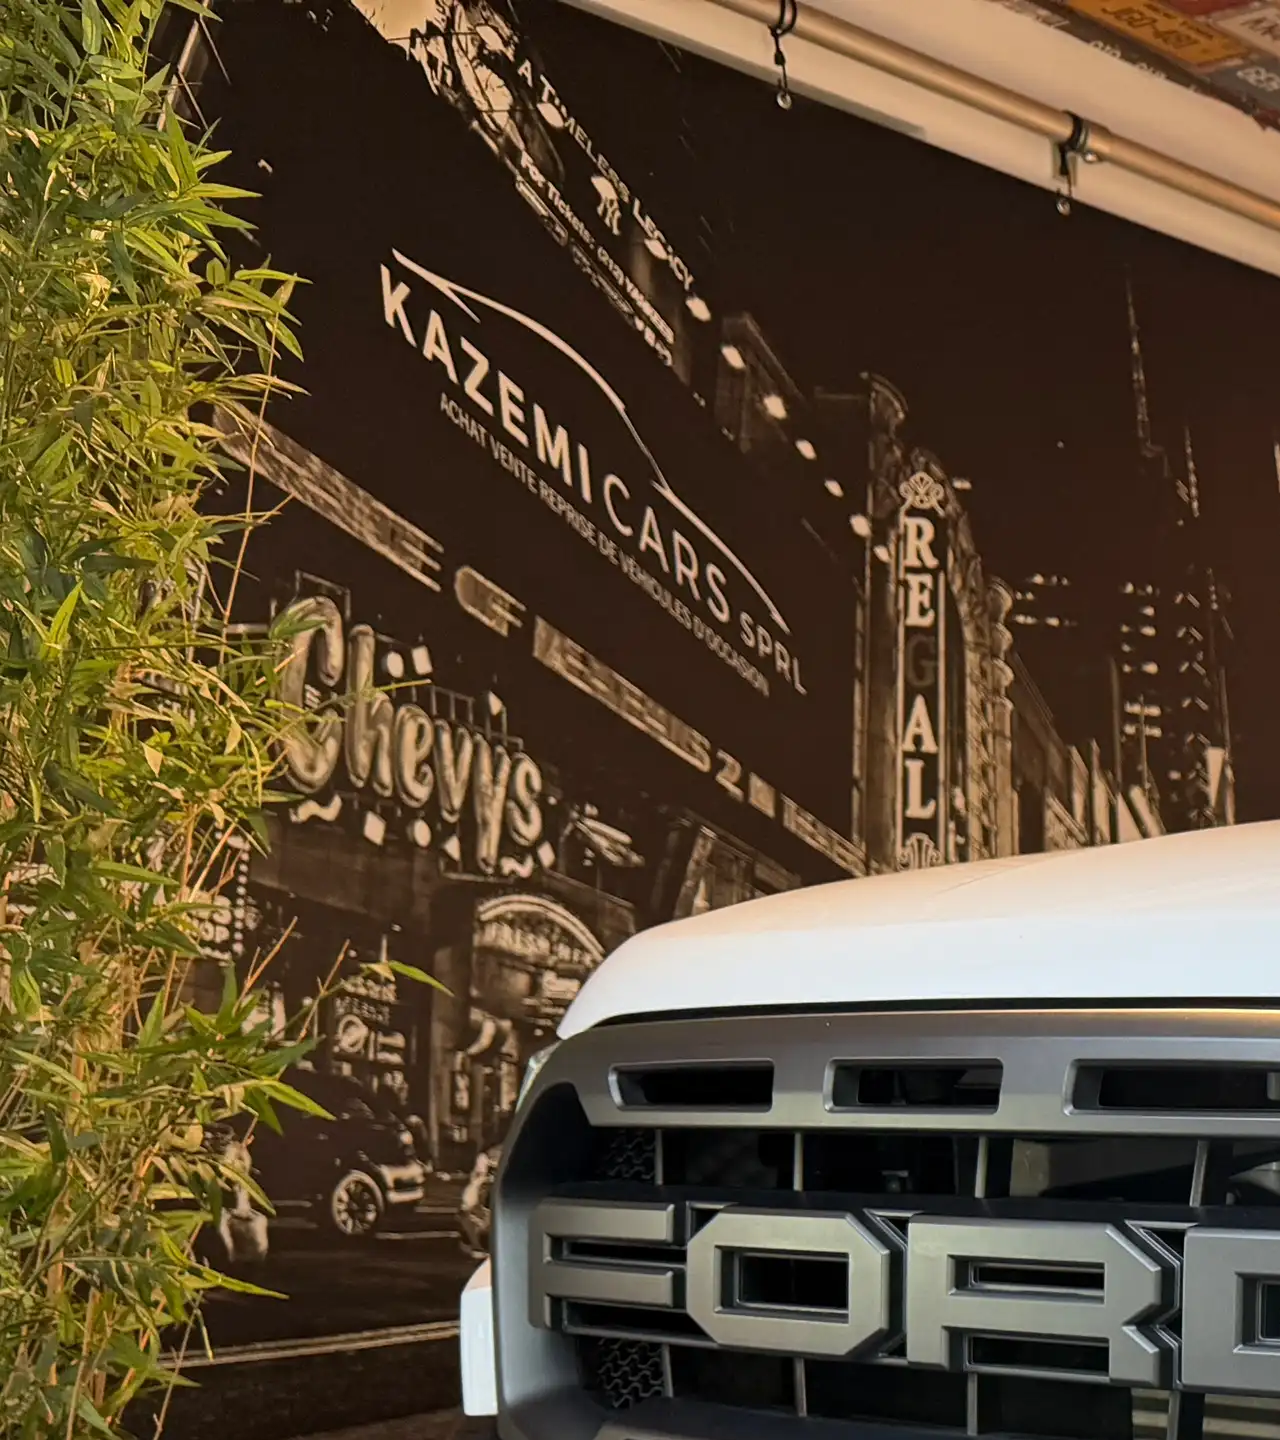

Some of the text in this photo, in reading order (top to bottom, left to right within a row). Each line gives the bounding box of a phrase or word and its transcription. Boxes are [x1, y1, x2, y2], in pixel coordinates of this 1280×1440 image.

[440, 391, 488, 450] ACHAT
[489, 433, 539, 496] VENTE
[539, 478, 598, 548] REPRISE
[597, 530, 620, 566] DE
[740, 610, 808, 697] SPRL
[902, 516, 941, 819] REGAL
